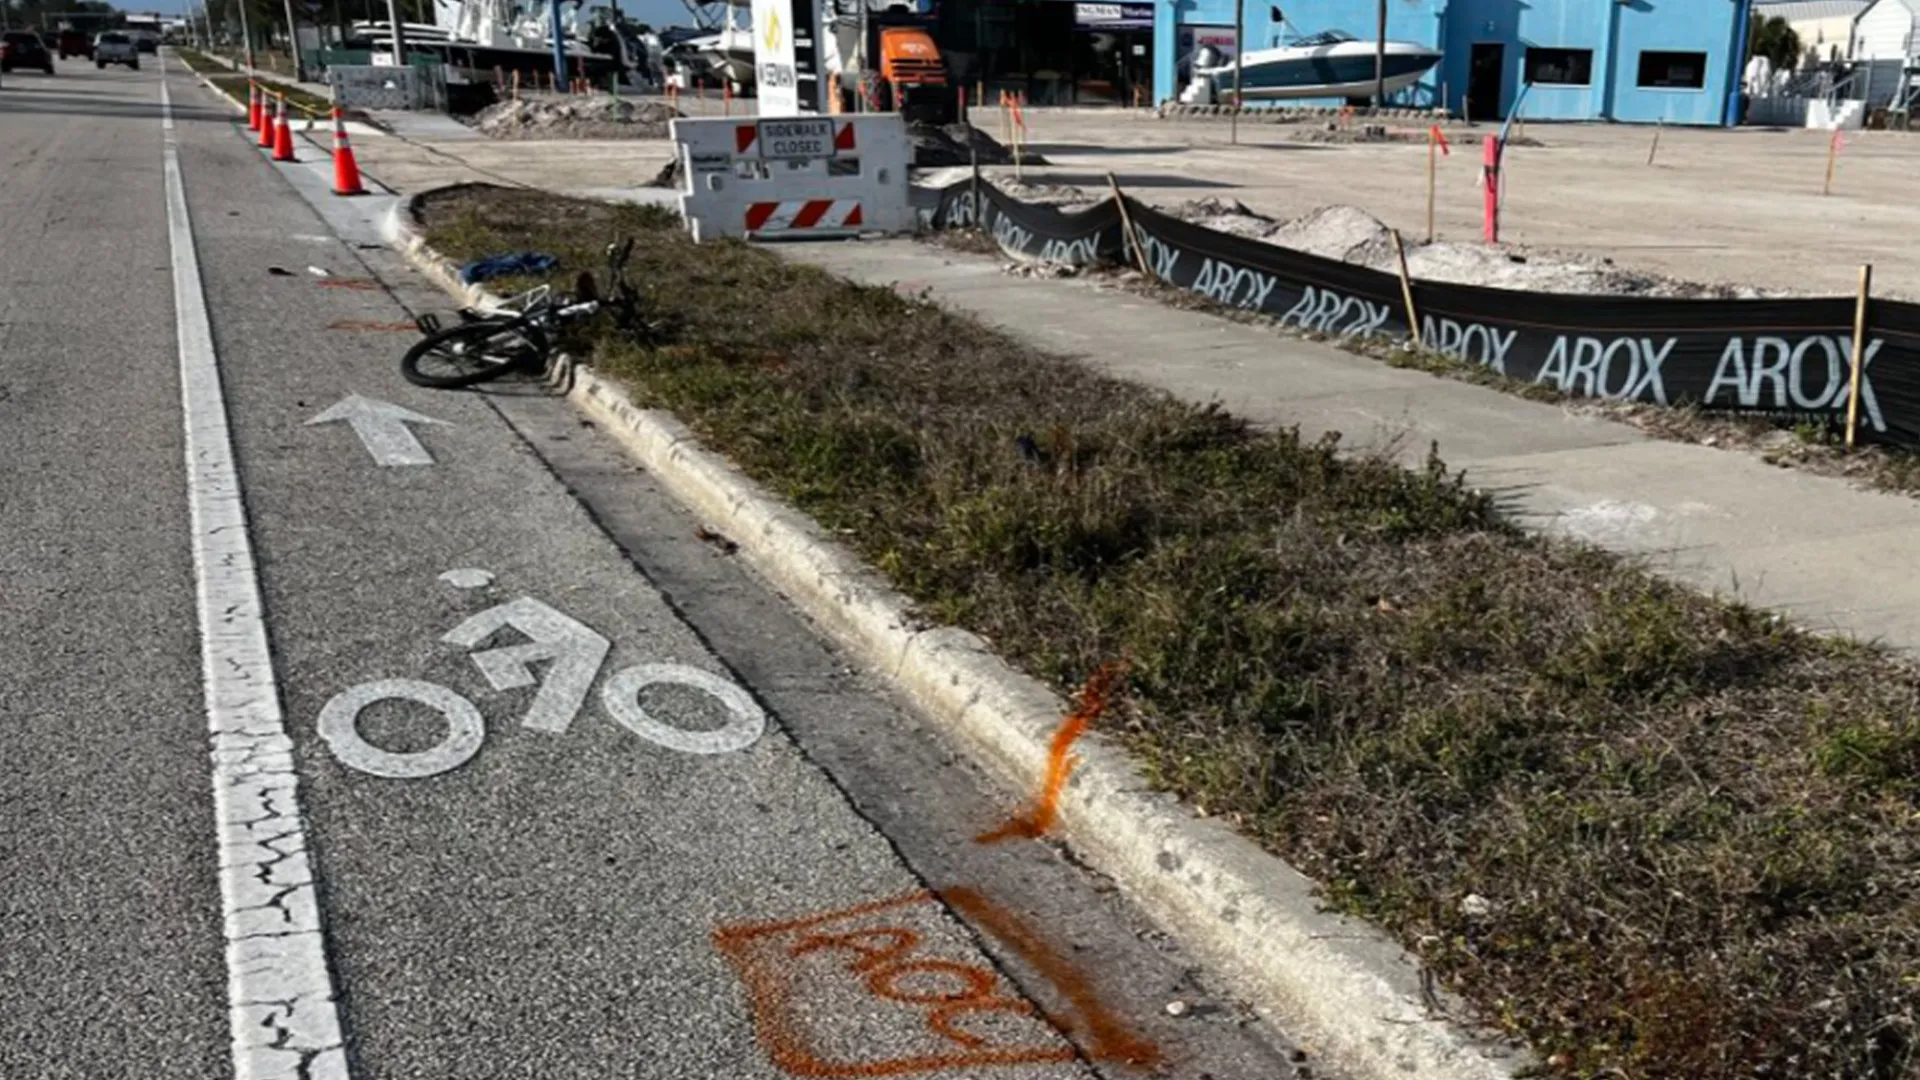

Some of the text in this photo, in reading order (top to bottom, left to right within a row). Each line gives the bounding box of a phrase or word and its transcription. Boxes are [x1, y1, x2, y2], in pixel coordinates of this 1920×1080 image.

[764, 124, 828, 137] SIDEWALK
[774, 140, 821, 154] CLOSED
[1192, 258, 1277, 310] AROX
[1282, 285, 1390, 338] AROX
[1421, 314, 1518, 376] AROX
[1536, 335, 1678, 405] AROX
[1703, 335, 1888, 433] AROX
